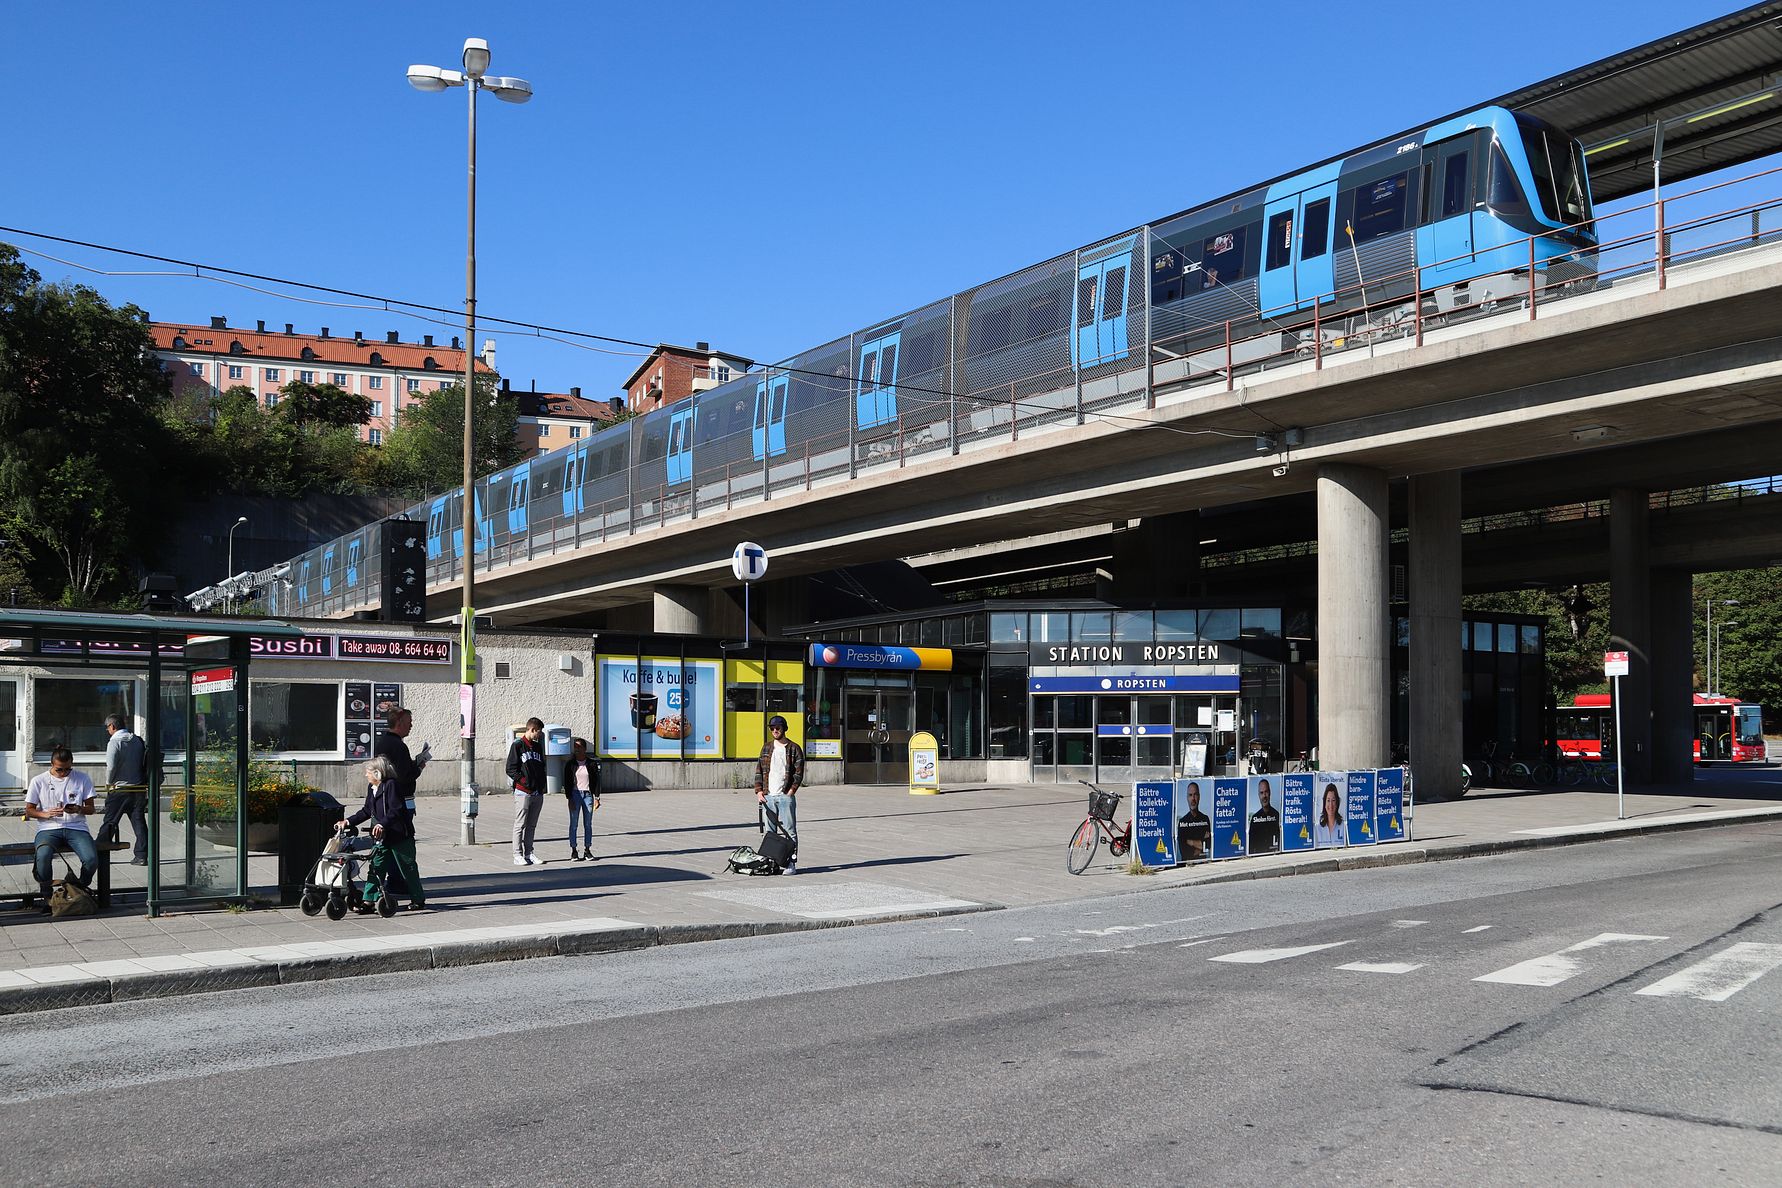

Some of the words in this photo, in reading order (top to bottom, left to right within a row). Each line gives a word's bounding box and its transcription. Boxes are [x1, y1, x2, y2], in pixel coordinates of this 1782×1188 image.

[744, 549, 763, 573] T
[250, 637, 322, 654] Sushi
[342, 639, 363, 653] Take
[365, 643, 387, 655] away
[405, 643, 421, 656] 664
[423, 643, 434, 656] 64
[436, 644, 447, 657] 40
[846, 649, 903, 665] Pressbyrån
[1049, 646, 1123, 662] STATION
[1144, 645, 1219, 661] ROPSTEN
[623, 669, 653, 684] Kafe
[656, 670, 664, 684] &
[667, 671, 697, 685] bule!
[1117, 679, 1166, 688] ROPSTEN
[1285, 779, 1302, 787] Bättre
[1349, 776, 1367, 784] Mindre
[1379, 777, 1389, 785] Fler
[1139, 788, 1159, 797] Bättre
[1216, 787, 1239, 796] Chatta
[1285, 788, 1311, 796] kollektiv-
[1139, 798, 1169, 807] kollektiv-
[1216, 799, 1232, 807] eller
[1285, 798, 1302, 806] trafik.
[1348, 795, 1369, 803] grupper
[1378, 797, 1392, 805] Rösta
[1139, 808, 1158, 817] trafik.
[1215, 807, 1236, 817] fatta?
[1285, 806, 1302, 815] Rösta
[1378, 806, 1397, 816] liberalt!
[1284, 815, 1308, 824] liberalt!
[1348, 812, 1369, 820] liberalt!
[1139, 818, 1157, 827] Rösta
[1138, 828, 1165, 837] liberalt!
